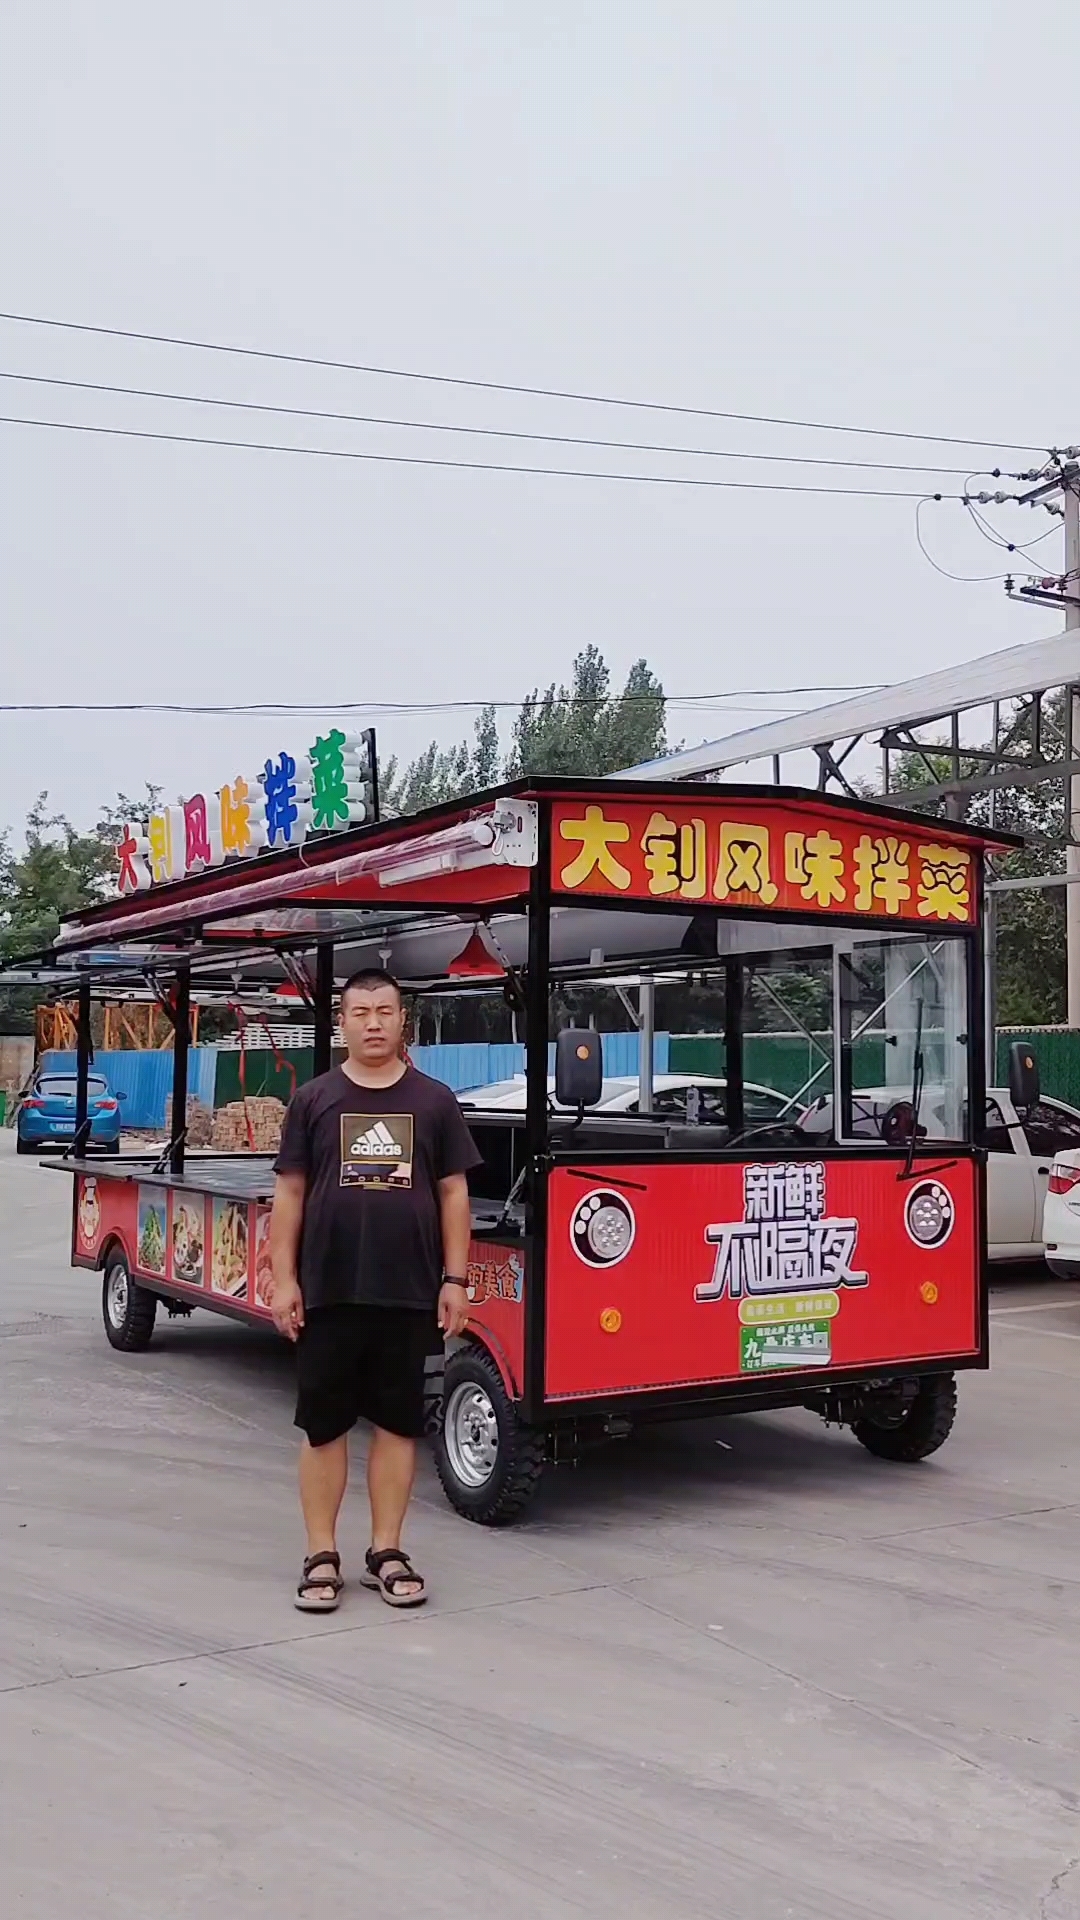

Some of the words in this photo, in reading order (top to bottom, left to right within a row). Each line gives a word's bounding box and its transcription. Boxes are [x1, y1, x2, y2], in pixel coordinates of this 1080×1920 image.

[558, 804, 971, 922] 大钊风味拌菜
[350, 1142, 402, 1156] adidas
[745, 1163, 824, 1221] 新鲜
[696, 1219, 868, 1298] 不隔夜
